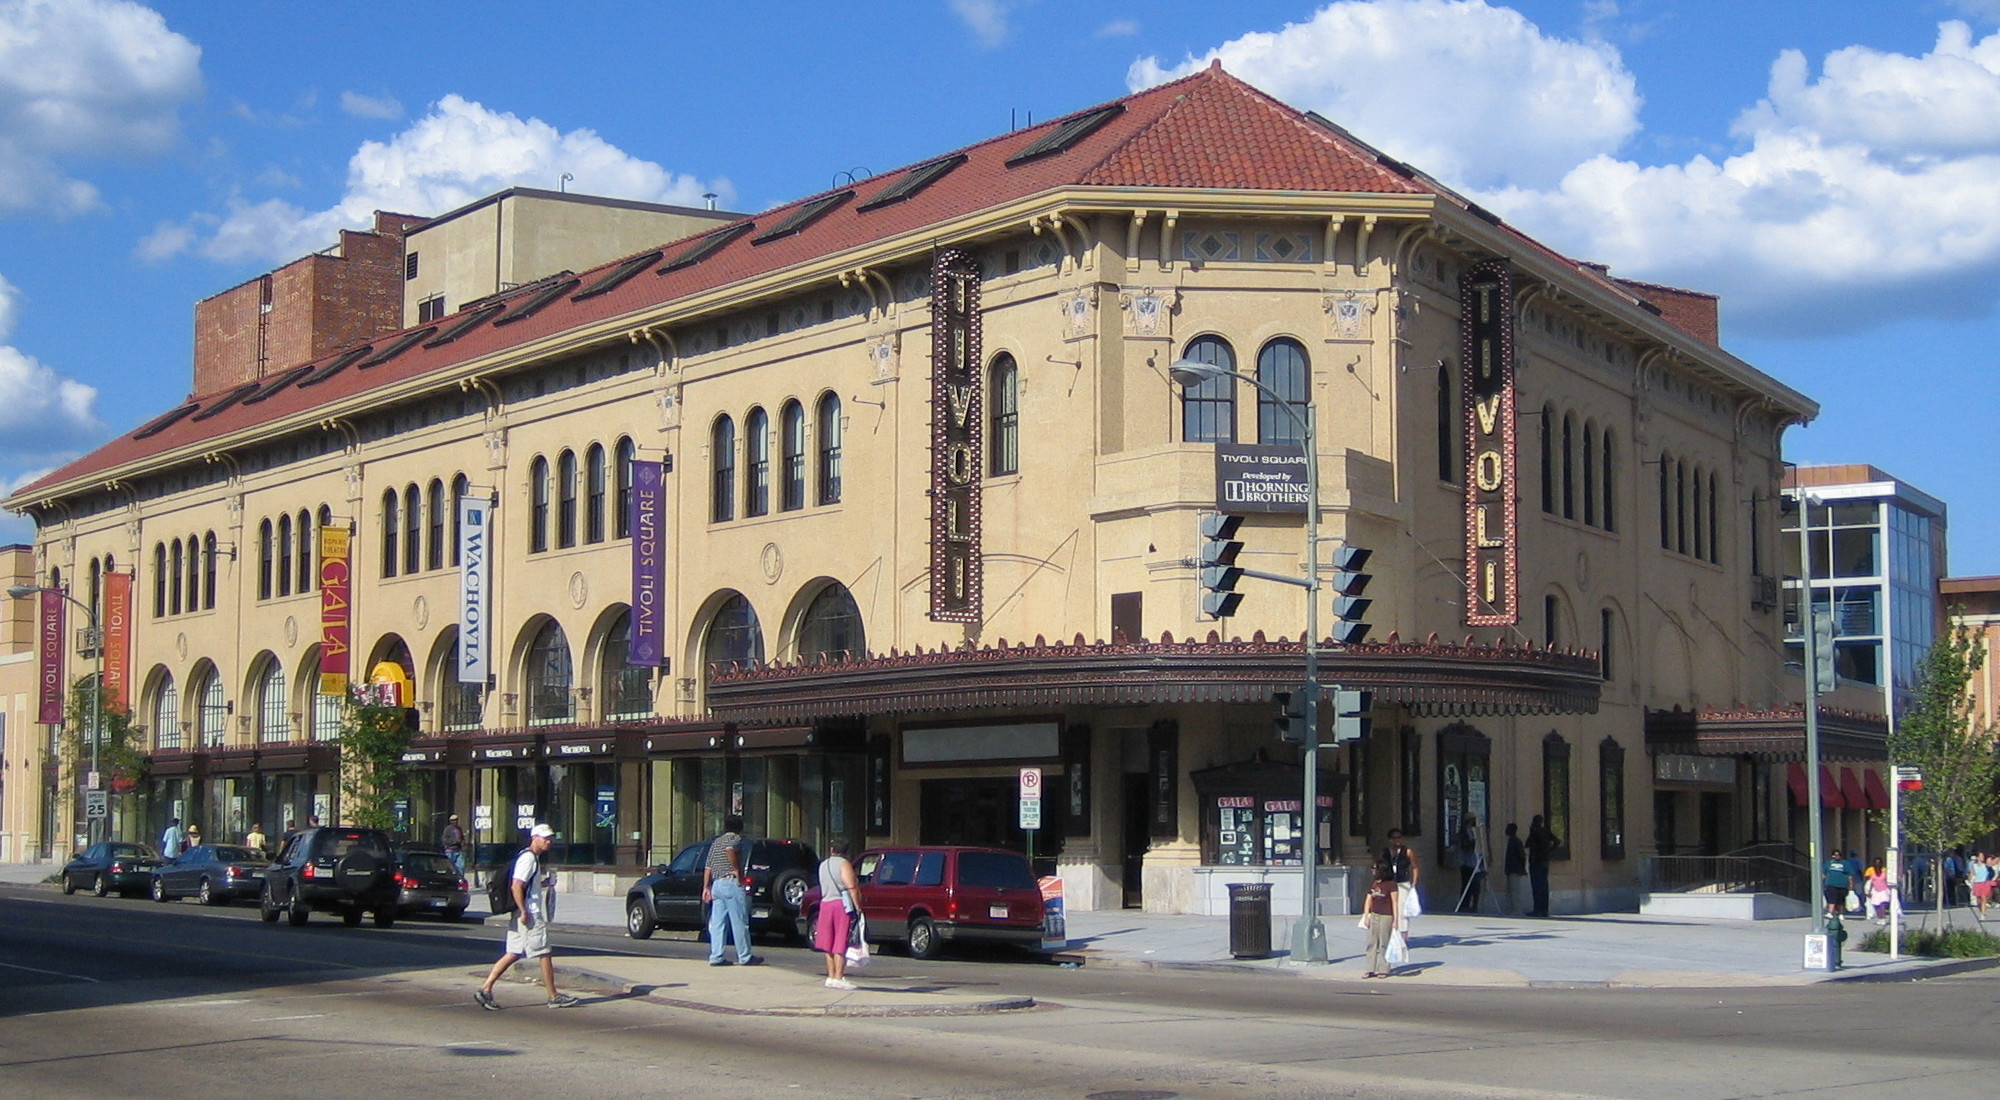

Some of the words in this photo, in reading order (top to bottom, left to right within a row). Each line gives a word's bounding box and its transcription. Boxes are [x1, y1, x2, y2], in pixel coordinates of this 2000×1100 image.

[947, 272, 973, 600] TIVOLI
[1472, 282, 1504, 604] TIVOLI
[1221, 454, 1259, 464] TIVOLI
[1242, 472, 1282, 482] Developed
[1282, 472, 1293, 482] by
[1246, 482, 1309, 493] HORNING
[1246, 492, 1309, 503] BROTHERS
[640, 490, 655, 567] SQUARE
[321, 557, 348, 658] GALA
[465, 532, 483, 671] WACHOVIA
[639, 574, 654, 636] TIVOLI
[110, 594, 123, 637] TIVOLI
[46, 607, 58, 658] SQUARE
[109, 641, 123, 690] SQUAR
[45, 663, 57, 704] TIVOLI
[1218, 796, 1250, 808] GALA
[1264, 800, 1297, 812] GALA
[87, 804, 105, 815] 25
[475, 805, 491, 816] NOW
[518, 804, 535, 816] NOW
[474, 817, 491, 830] OPEN
[517, 817, 535, 830] OPEN
